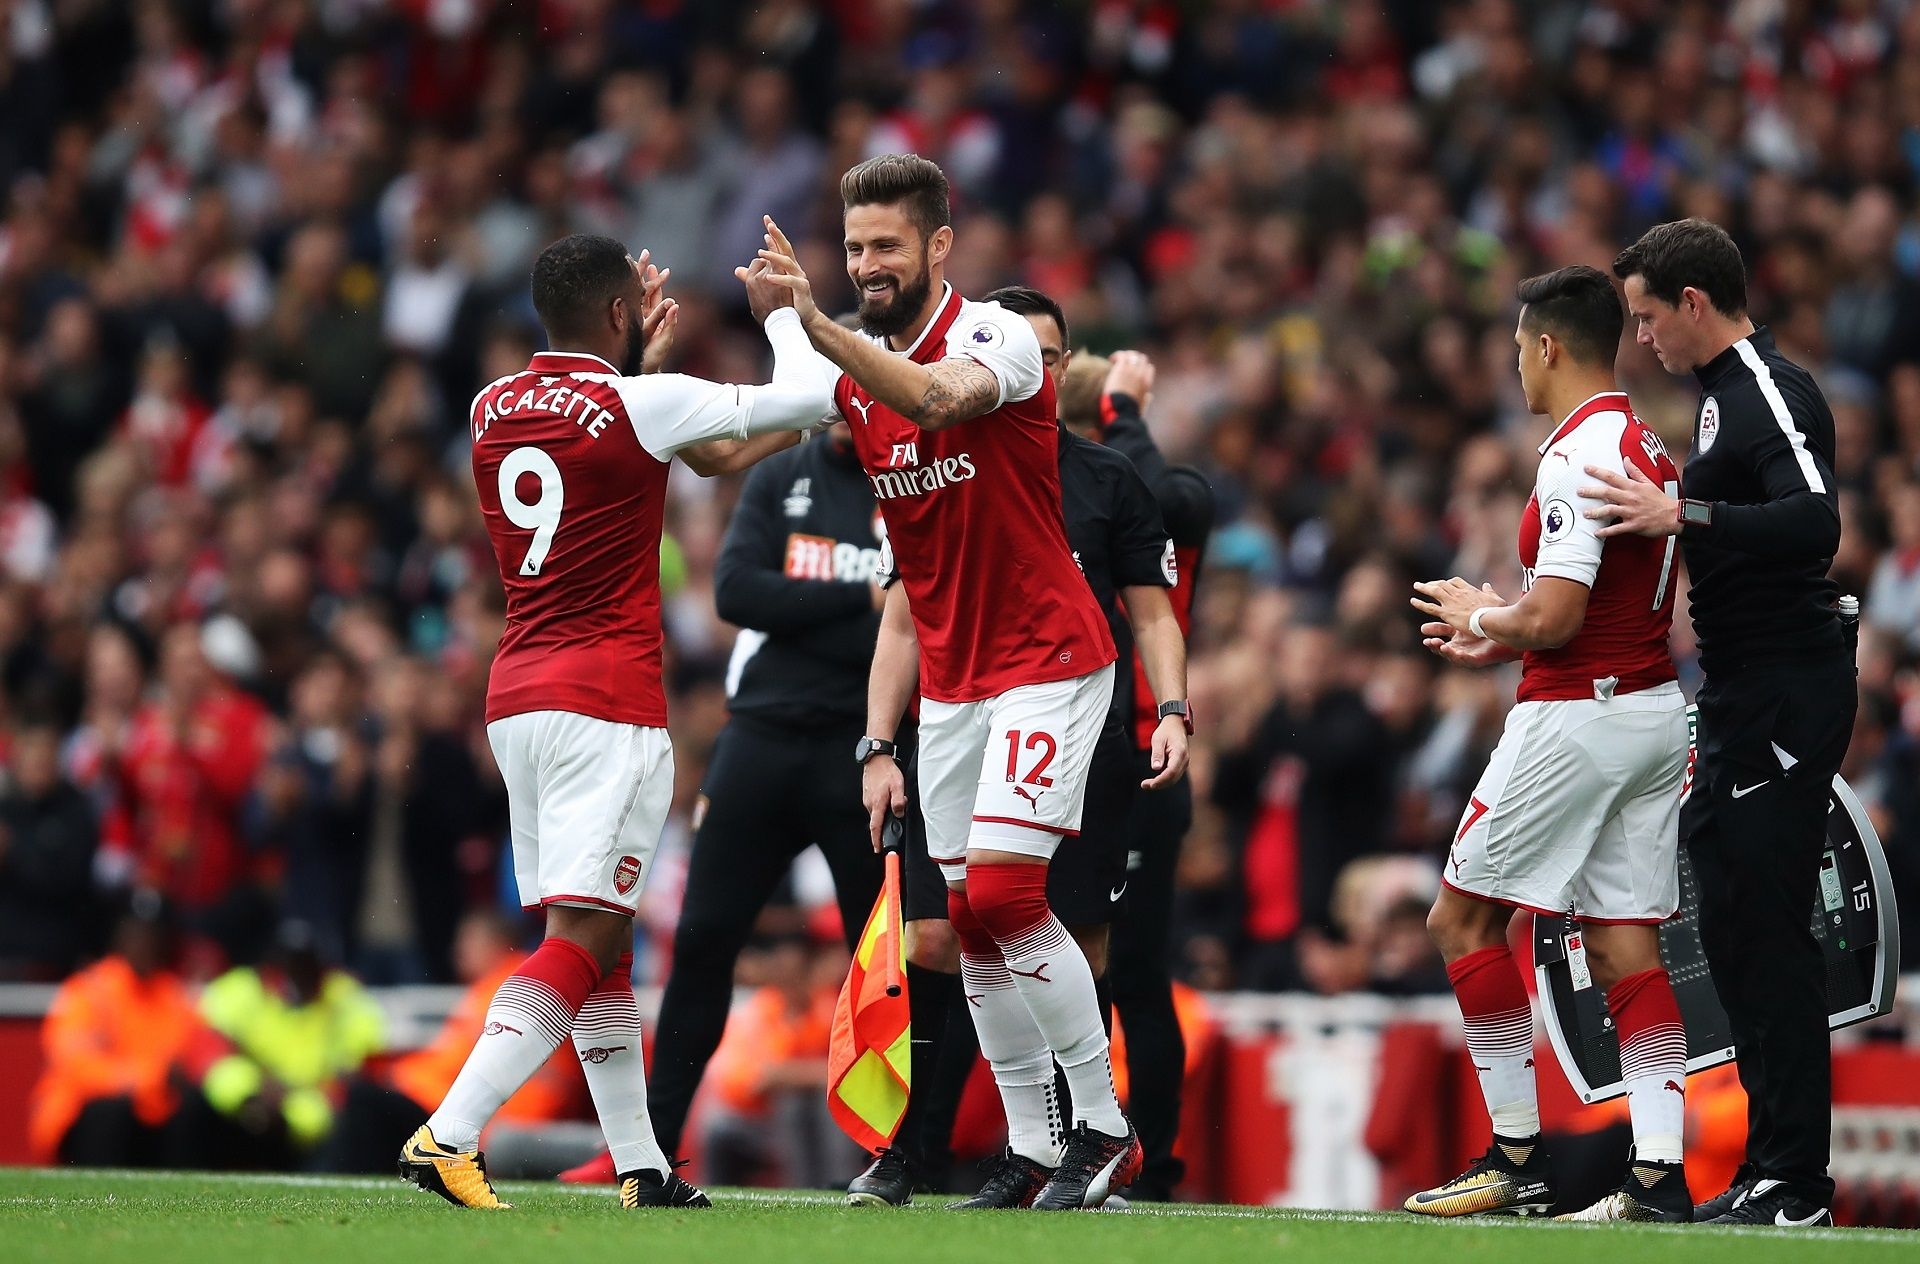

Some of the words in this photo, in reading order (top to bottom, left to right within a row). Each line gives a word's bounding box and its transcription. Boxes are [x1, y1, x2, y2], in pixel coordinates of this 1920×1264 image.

[474, 386, 615, 443] LACAZETTE
[1702, 409, 1716, 430] EA
[864, 453, 976, 499] mirates
[497, 446, 565, 576] 9
[1005, 729, 1057, 788] 12
[1455, 795, 1489, 847] 7
[1852, 879, 1871, 912] 15
